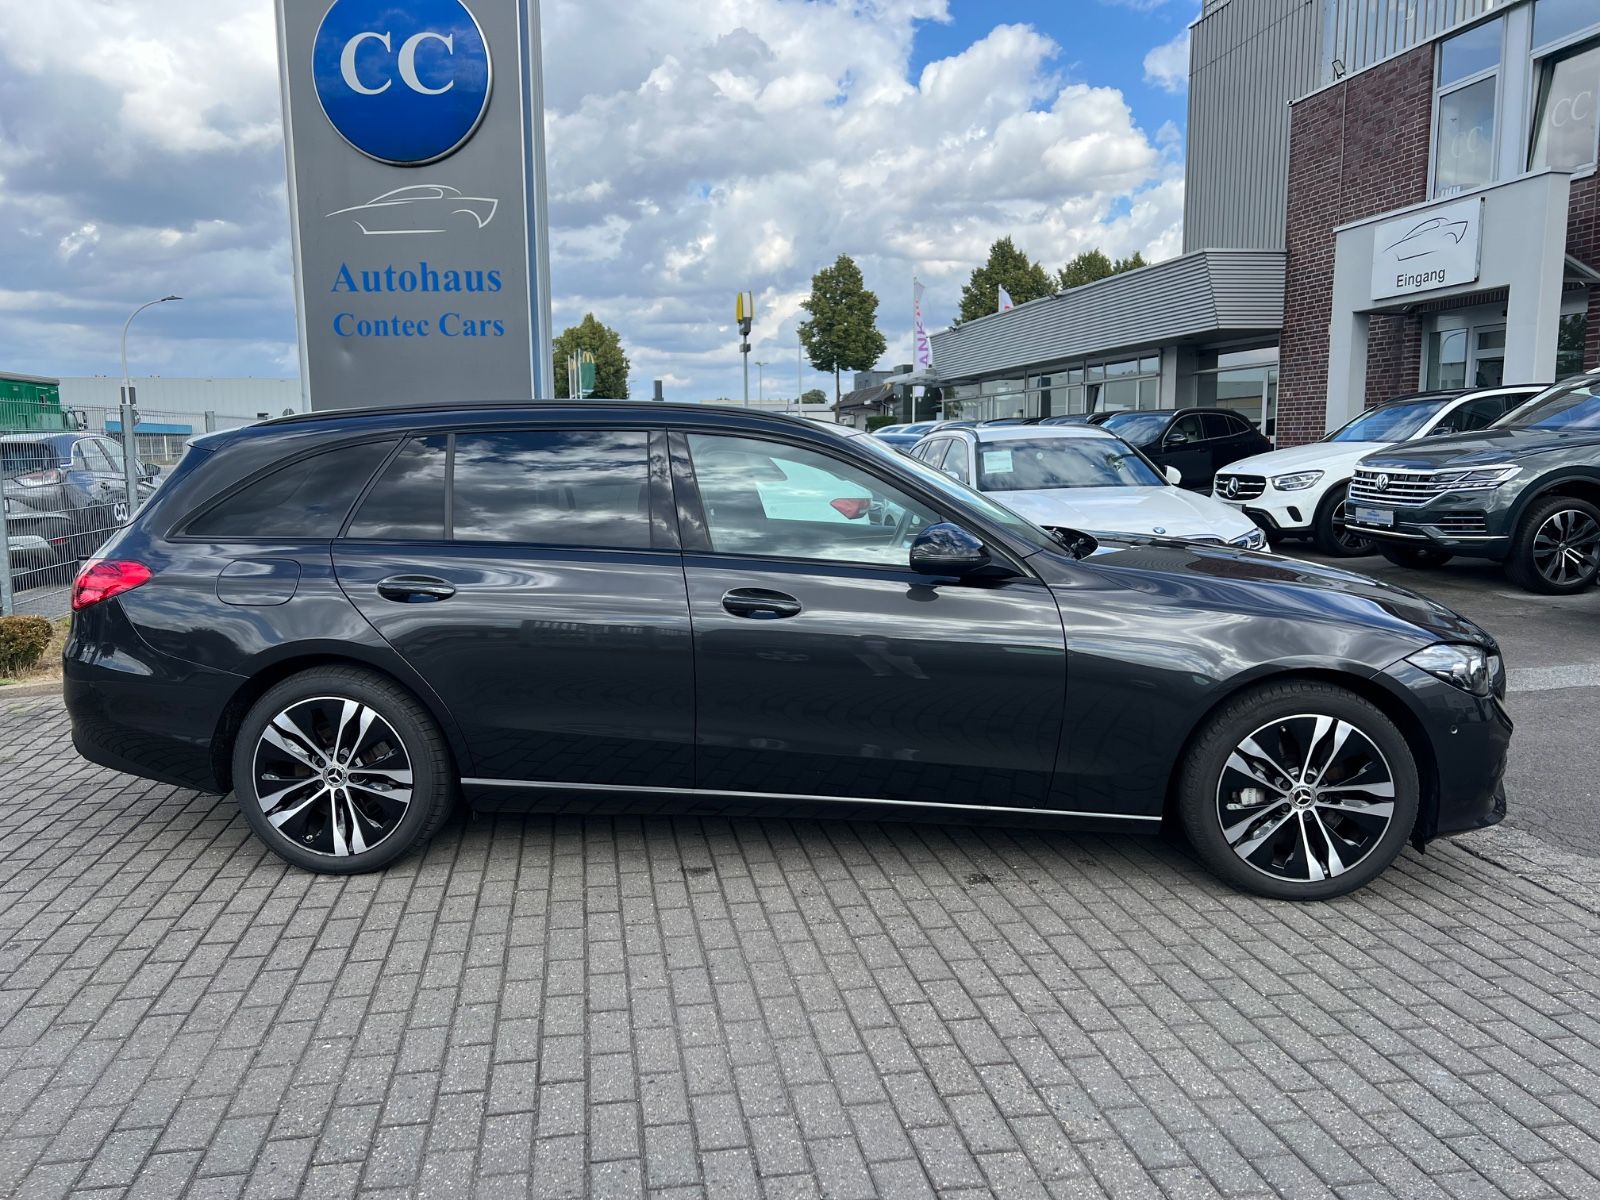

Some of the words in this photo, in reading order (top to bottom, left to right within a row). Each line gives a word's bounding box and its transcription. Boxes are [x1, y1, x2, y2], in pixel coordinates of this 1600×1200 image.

[340, 31, 454, 95] CC
[1551, 91, 1592, 128] CC
[330, 261, 503, 293] Autohaus
[1396, 268, 1446, 288] Eingang
[333, 312, 429, 337] Contec
[438, 312, 505, 337] Cars
